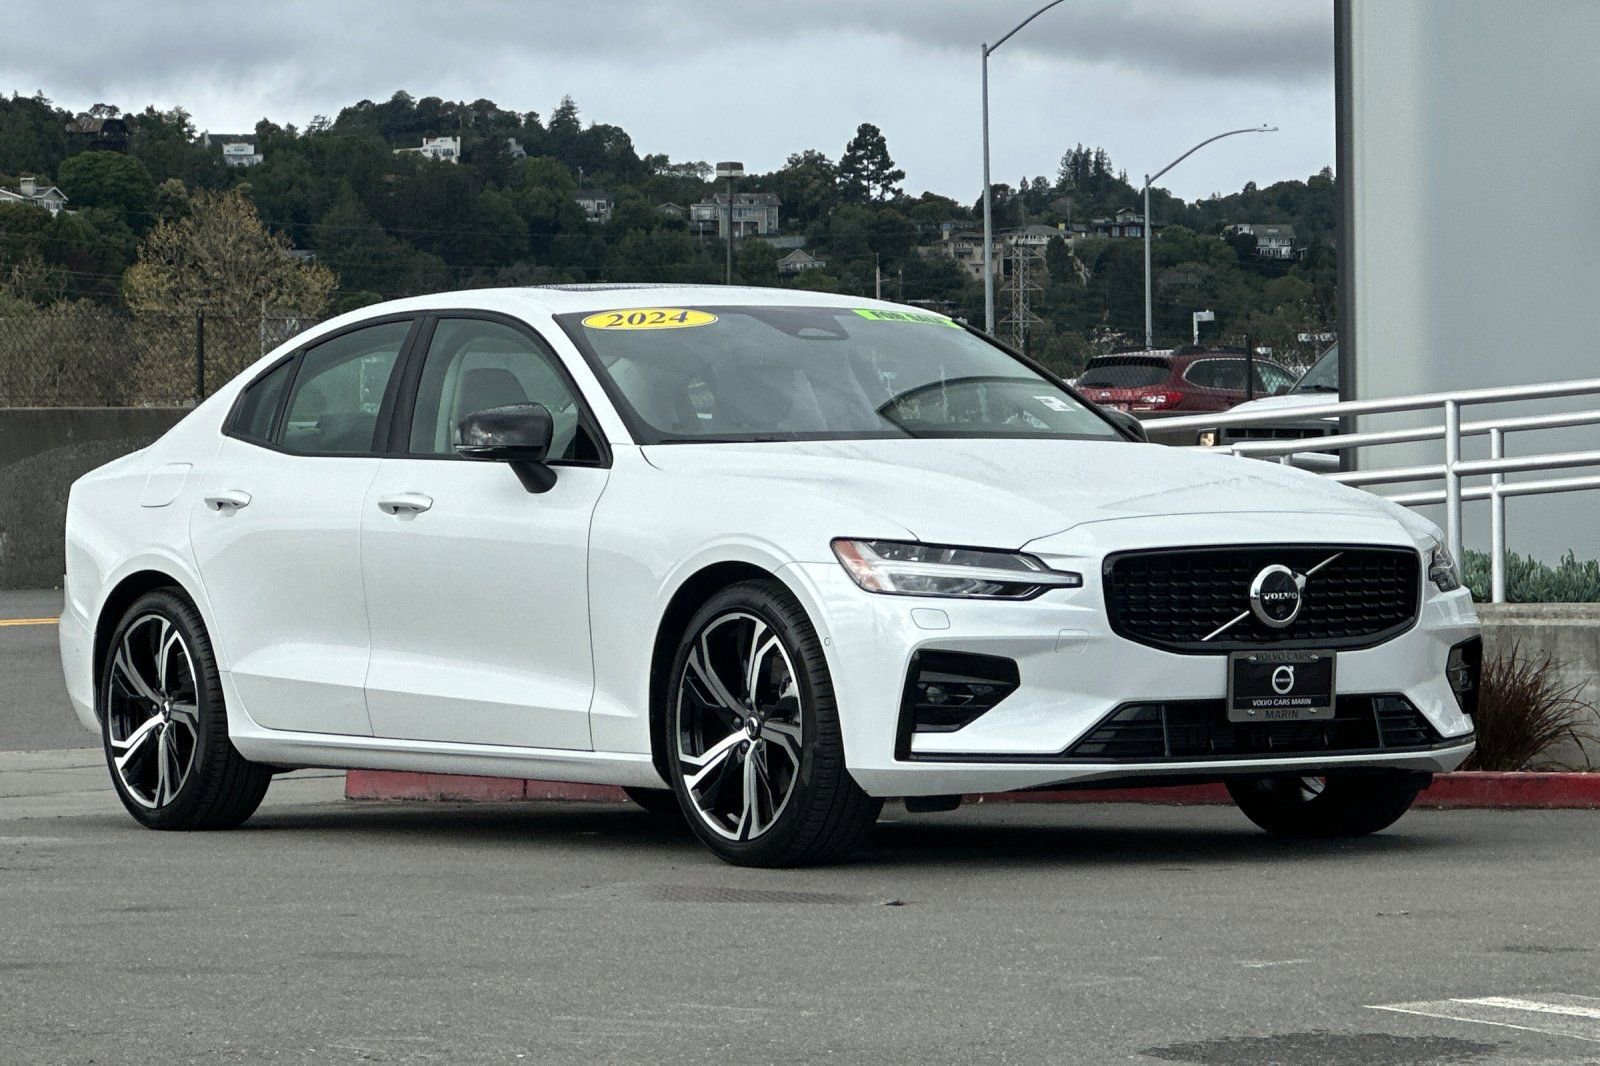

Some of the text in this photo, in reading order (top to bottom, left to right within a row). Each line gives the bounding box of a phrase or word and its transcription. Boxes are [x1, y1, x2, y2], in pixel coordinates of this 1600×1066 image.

[605, 311, 689, 328] 2024
[1261, 592, 1298, 600] VOLVO
[1256, 652, 1285, 661] VOLVO
[1252, 699, 1273, 707] VOLVO
[1273, 698, 1291, 706] CARS
[1264, 709, 1299, 720] MARIN
